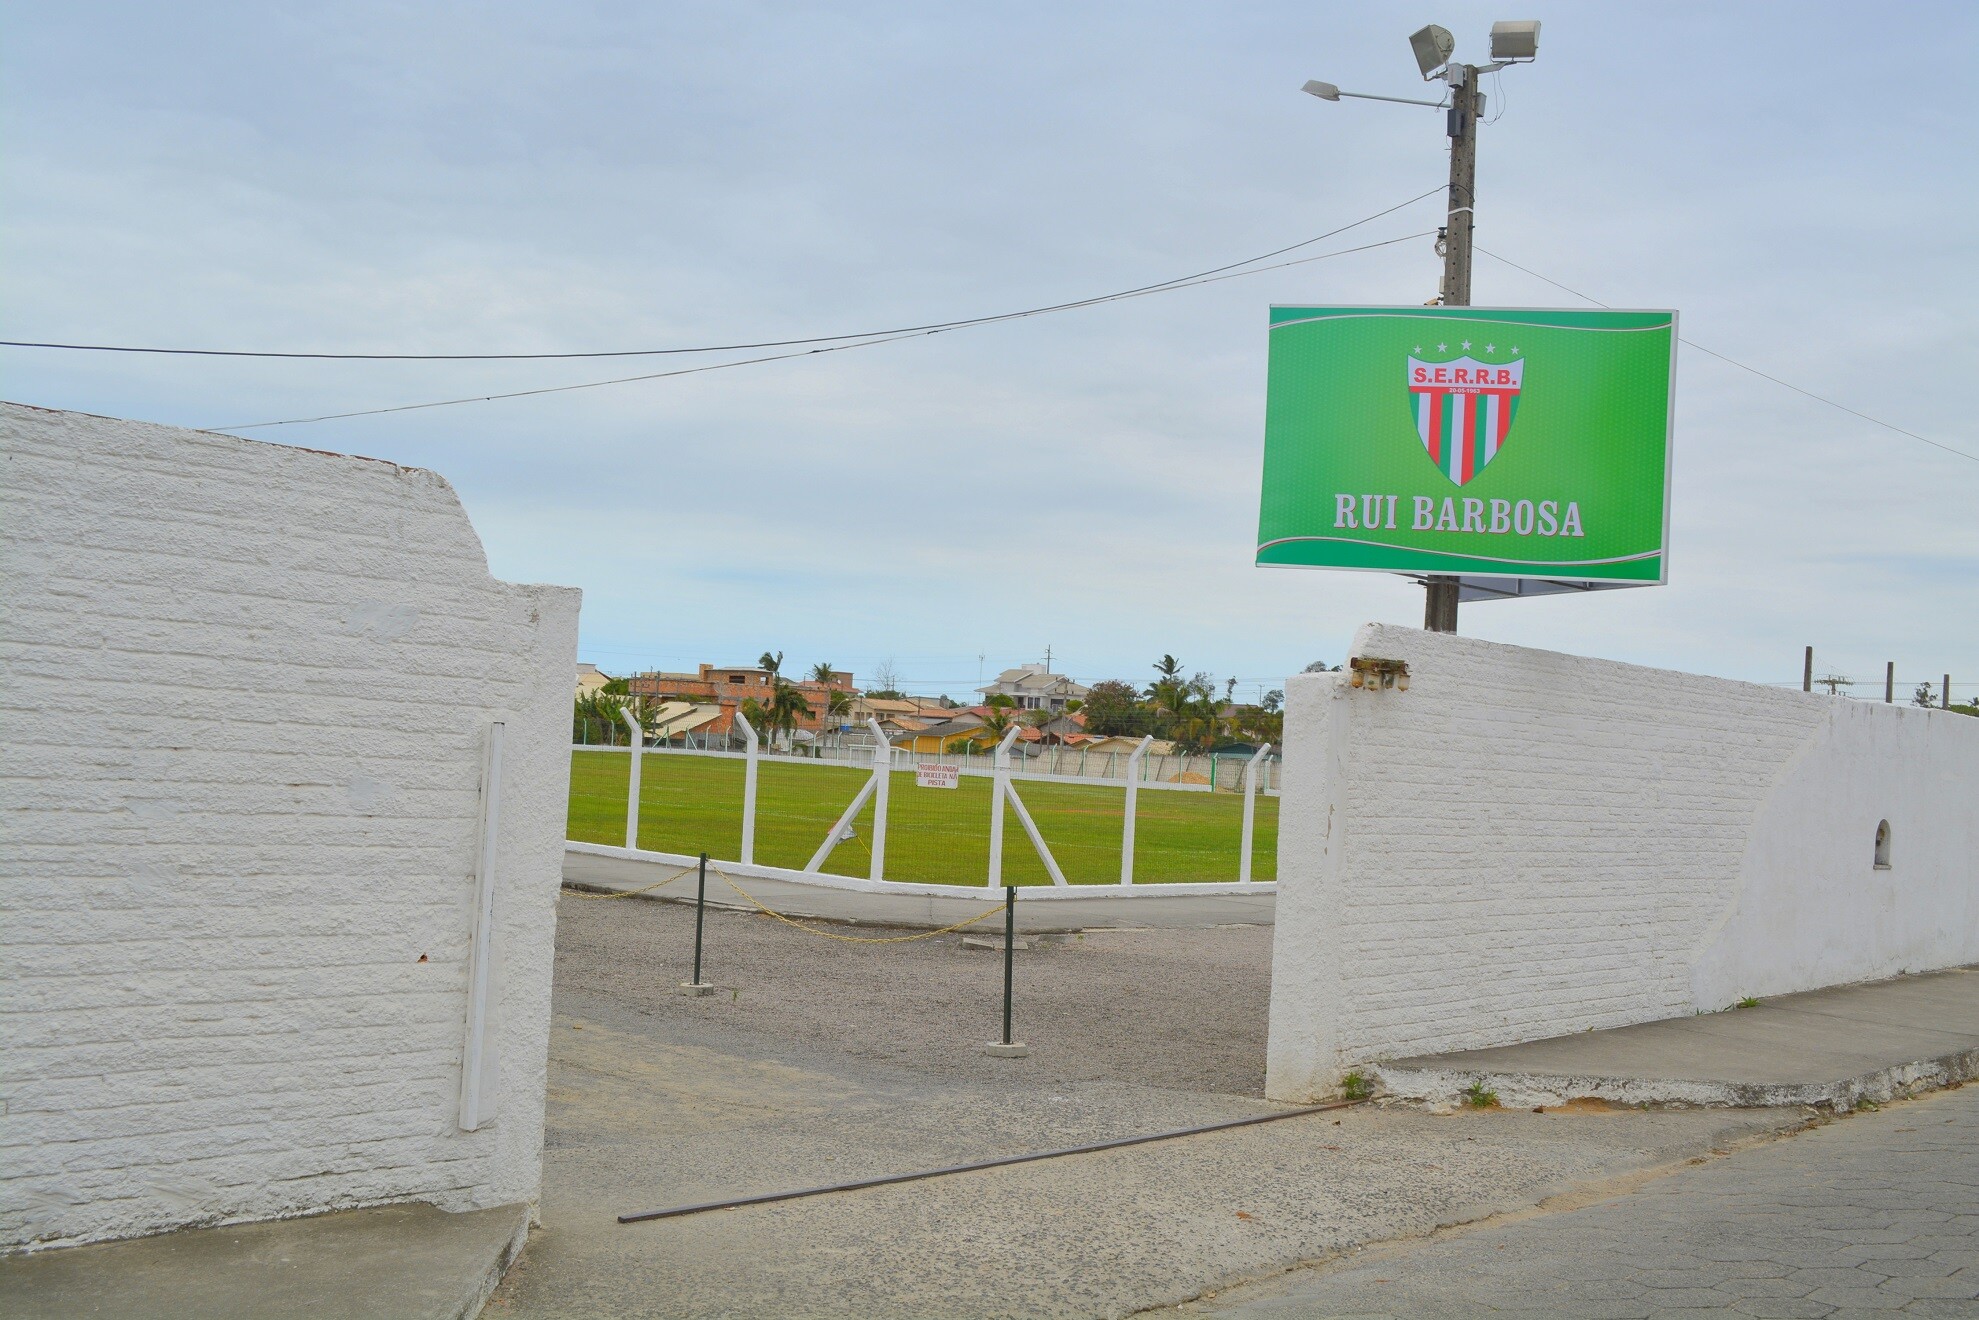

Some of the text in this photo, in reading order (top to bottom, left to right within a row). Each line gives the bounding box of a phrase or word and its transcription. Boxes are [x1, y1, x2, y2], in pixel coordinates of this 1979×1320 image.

[1413, 367, 1517, 385] S.E.R.R.B.
[1333, 493, 1585, 537] RUI BARBOSA
